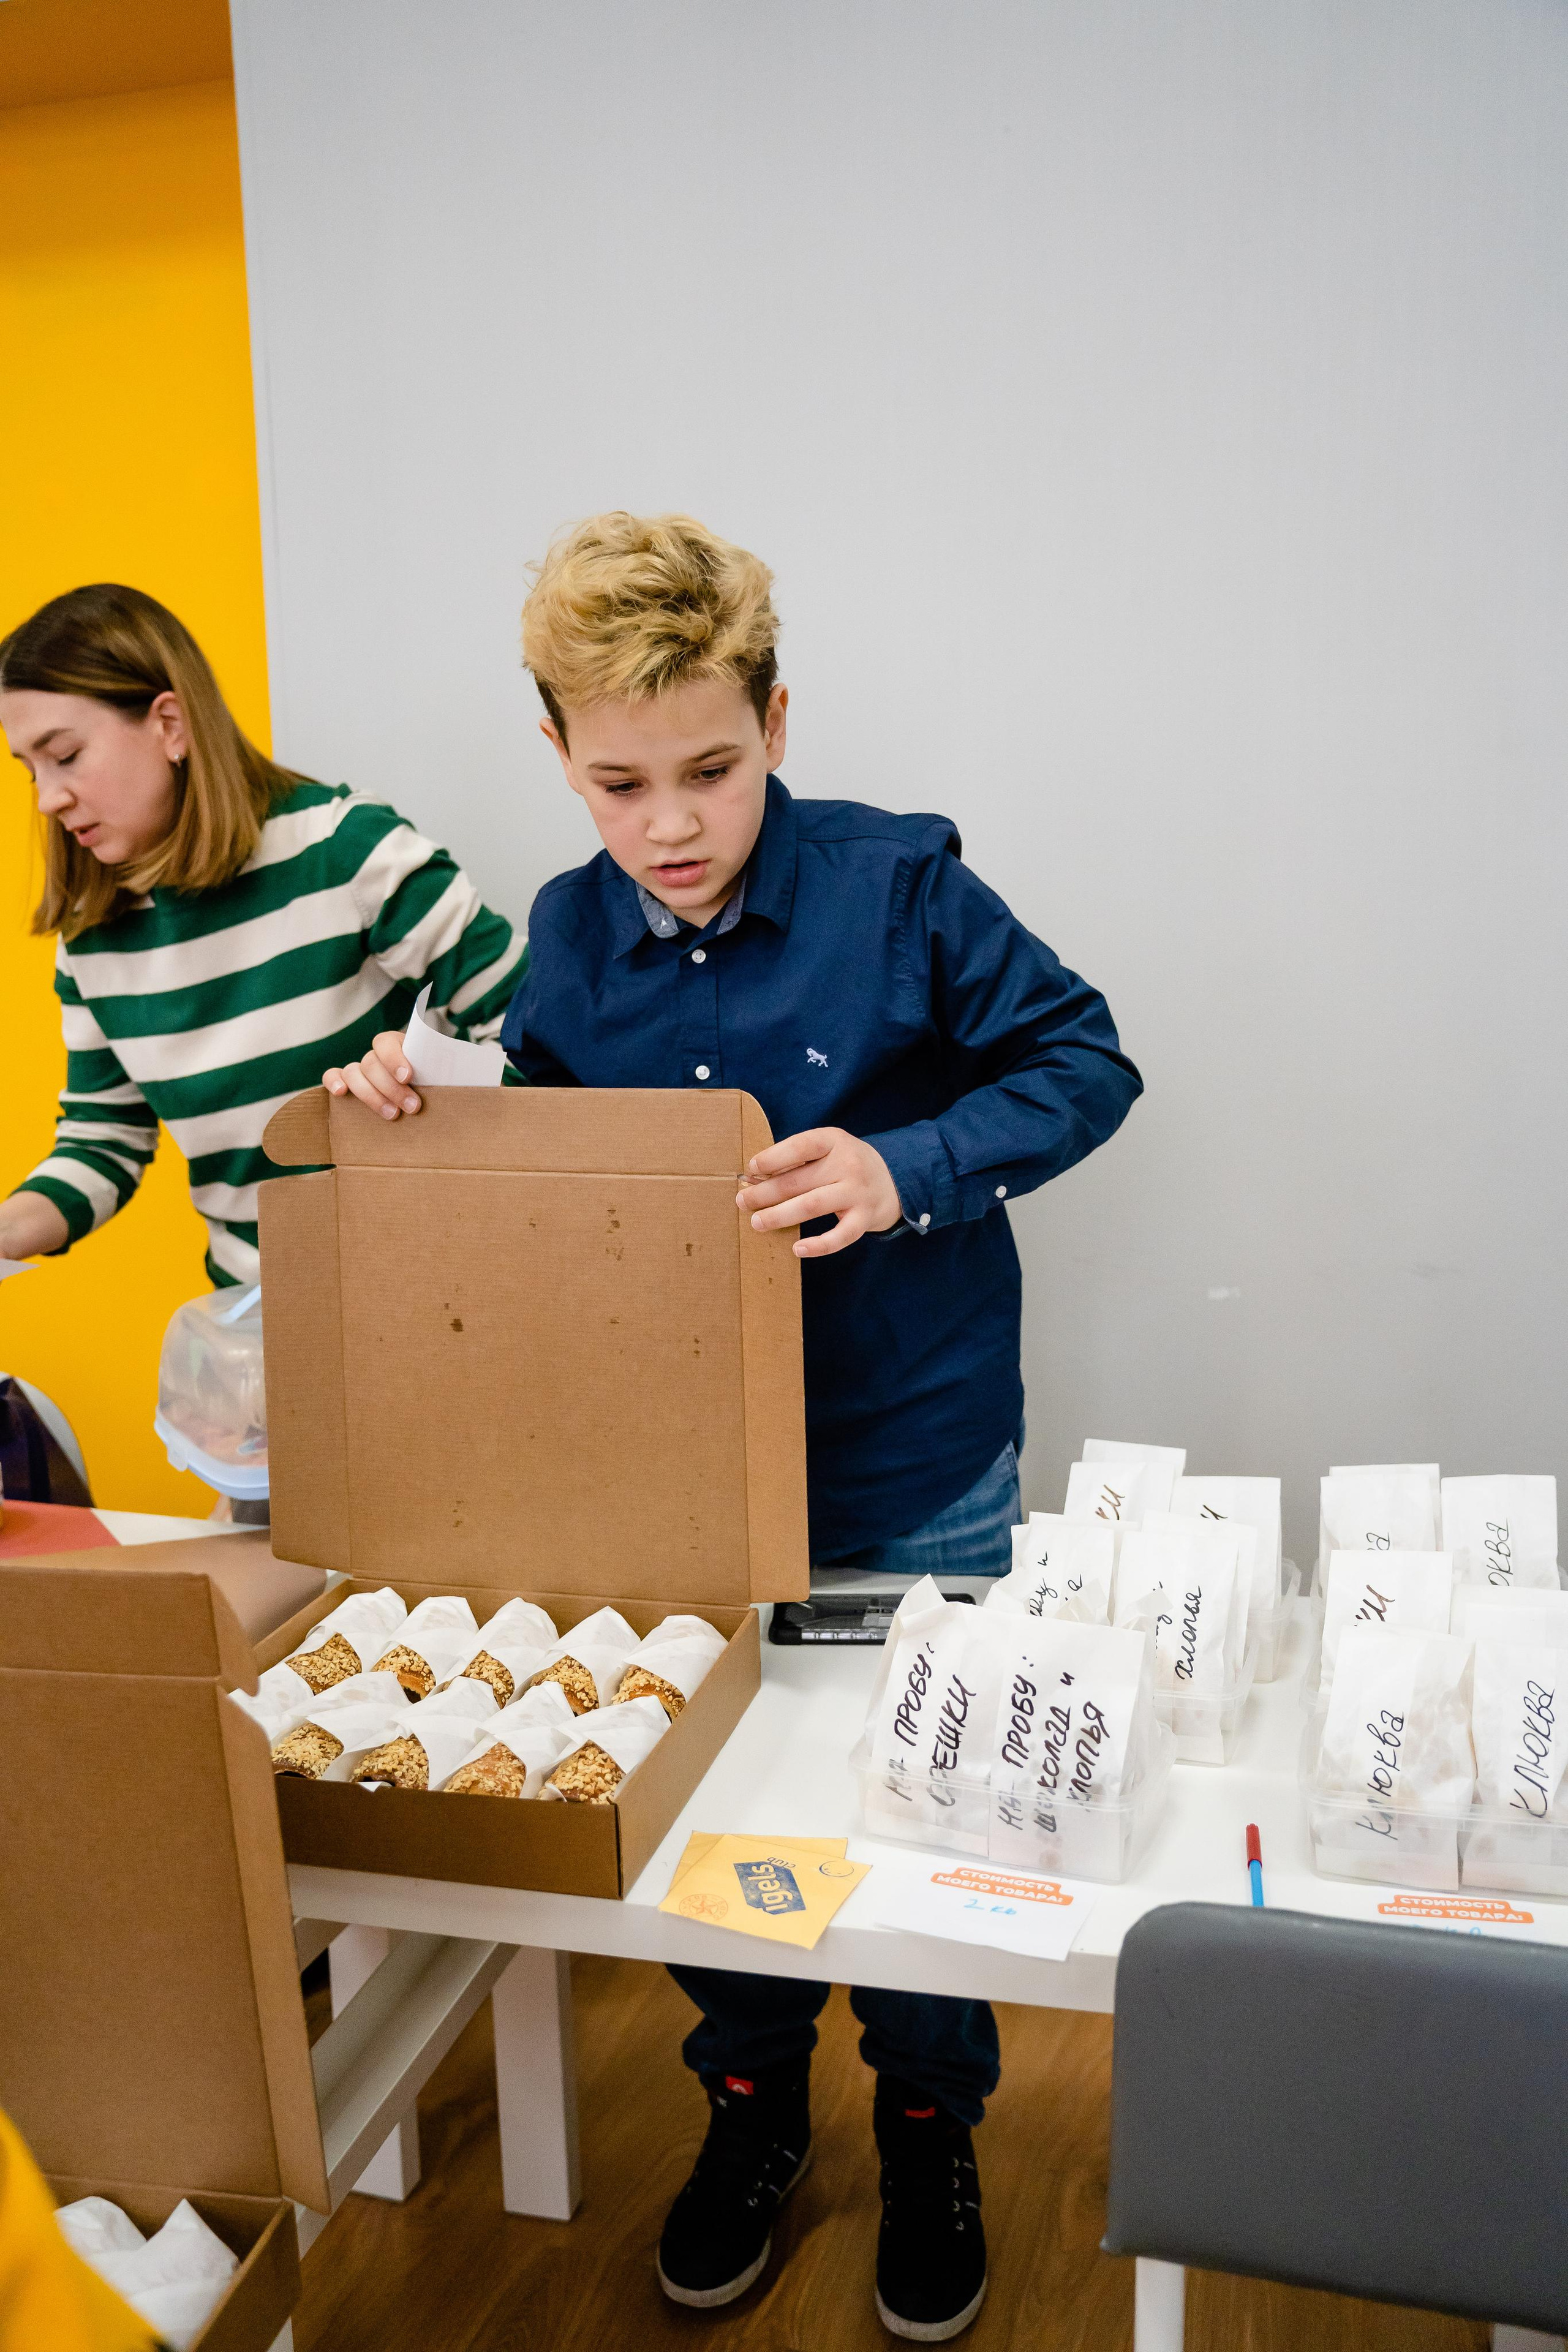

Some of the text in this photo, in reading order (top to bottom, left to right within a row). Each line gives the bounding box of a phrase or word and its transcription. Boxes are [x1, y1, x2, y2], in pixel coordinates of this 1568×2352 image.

[937, 1875, 1063, 1902] МОЕГО ТОВАРА:
[959, 1870, 1055, 1891] СТОИМОСТЬ
[1384, 1905, 1524, 1921] МОЕГО ТОВАРА:
[1400, 1898, 1506, 1910] СТОИМОСТЬ
